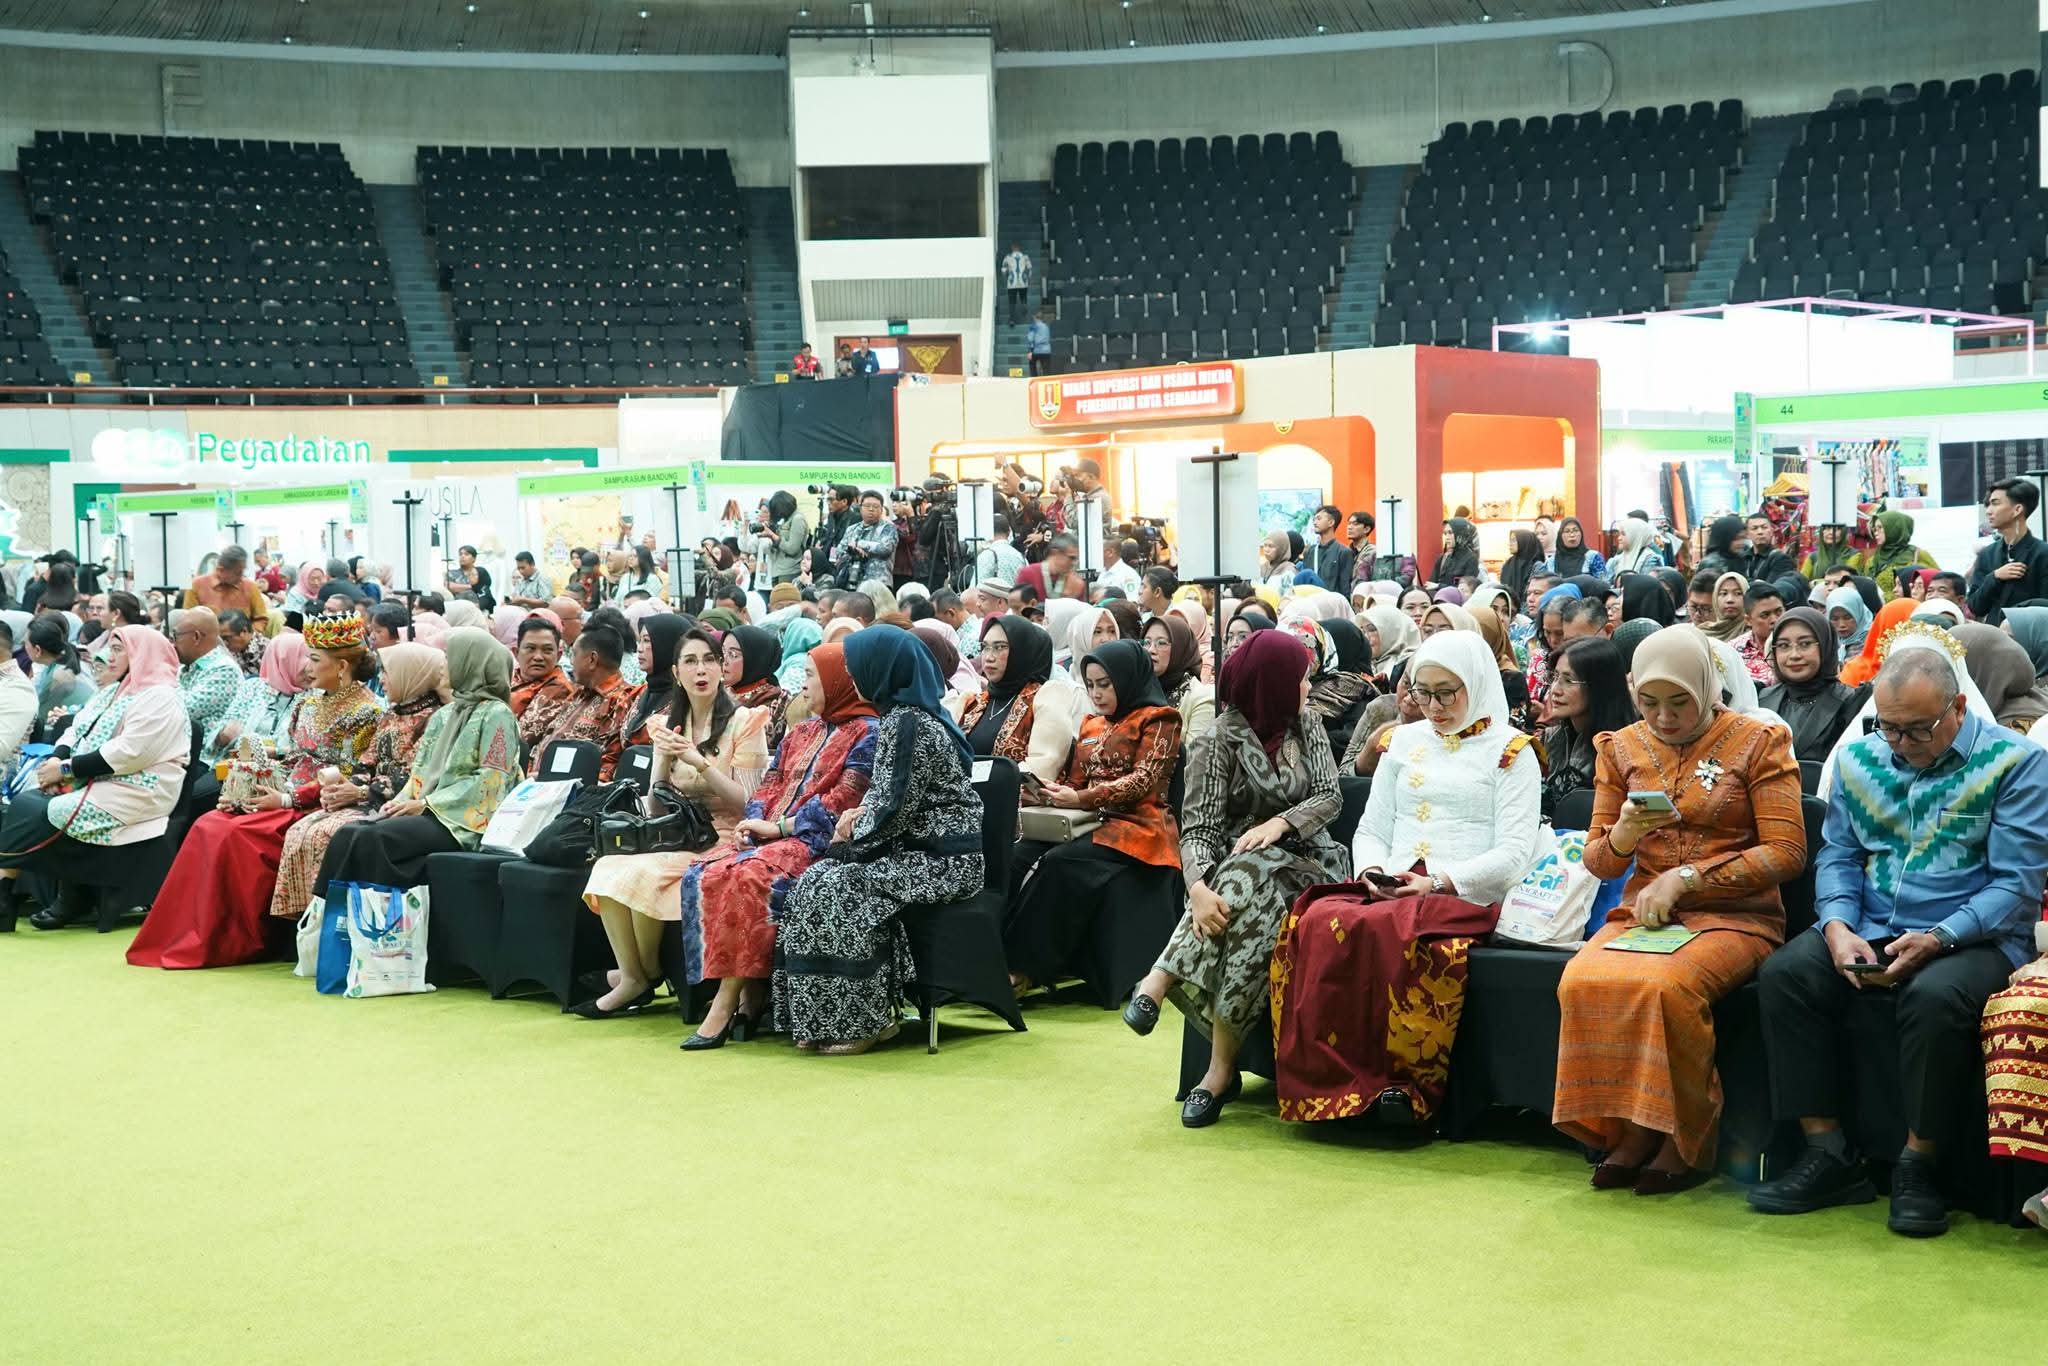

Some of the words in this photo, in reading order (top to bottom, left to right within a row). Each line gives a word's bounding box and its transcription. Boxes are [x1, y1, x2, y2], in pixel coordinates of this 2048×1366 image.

[1780, 404, 1794, 415] 44
[198, 432, 371, 470] Pegadaian
[647, 471, 678, 482] BANDUNG
[800, 471, 847, 480] SAMPURASUN
[848, 471, 881, 480] BANDUNG
